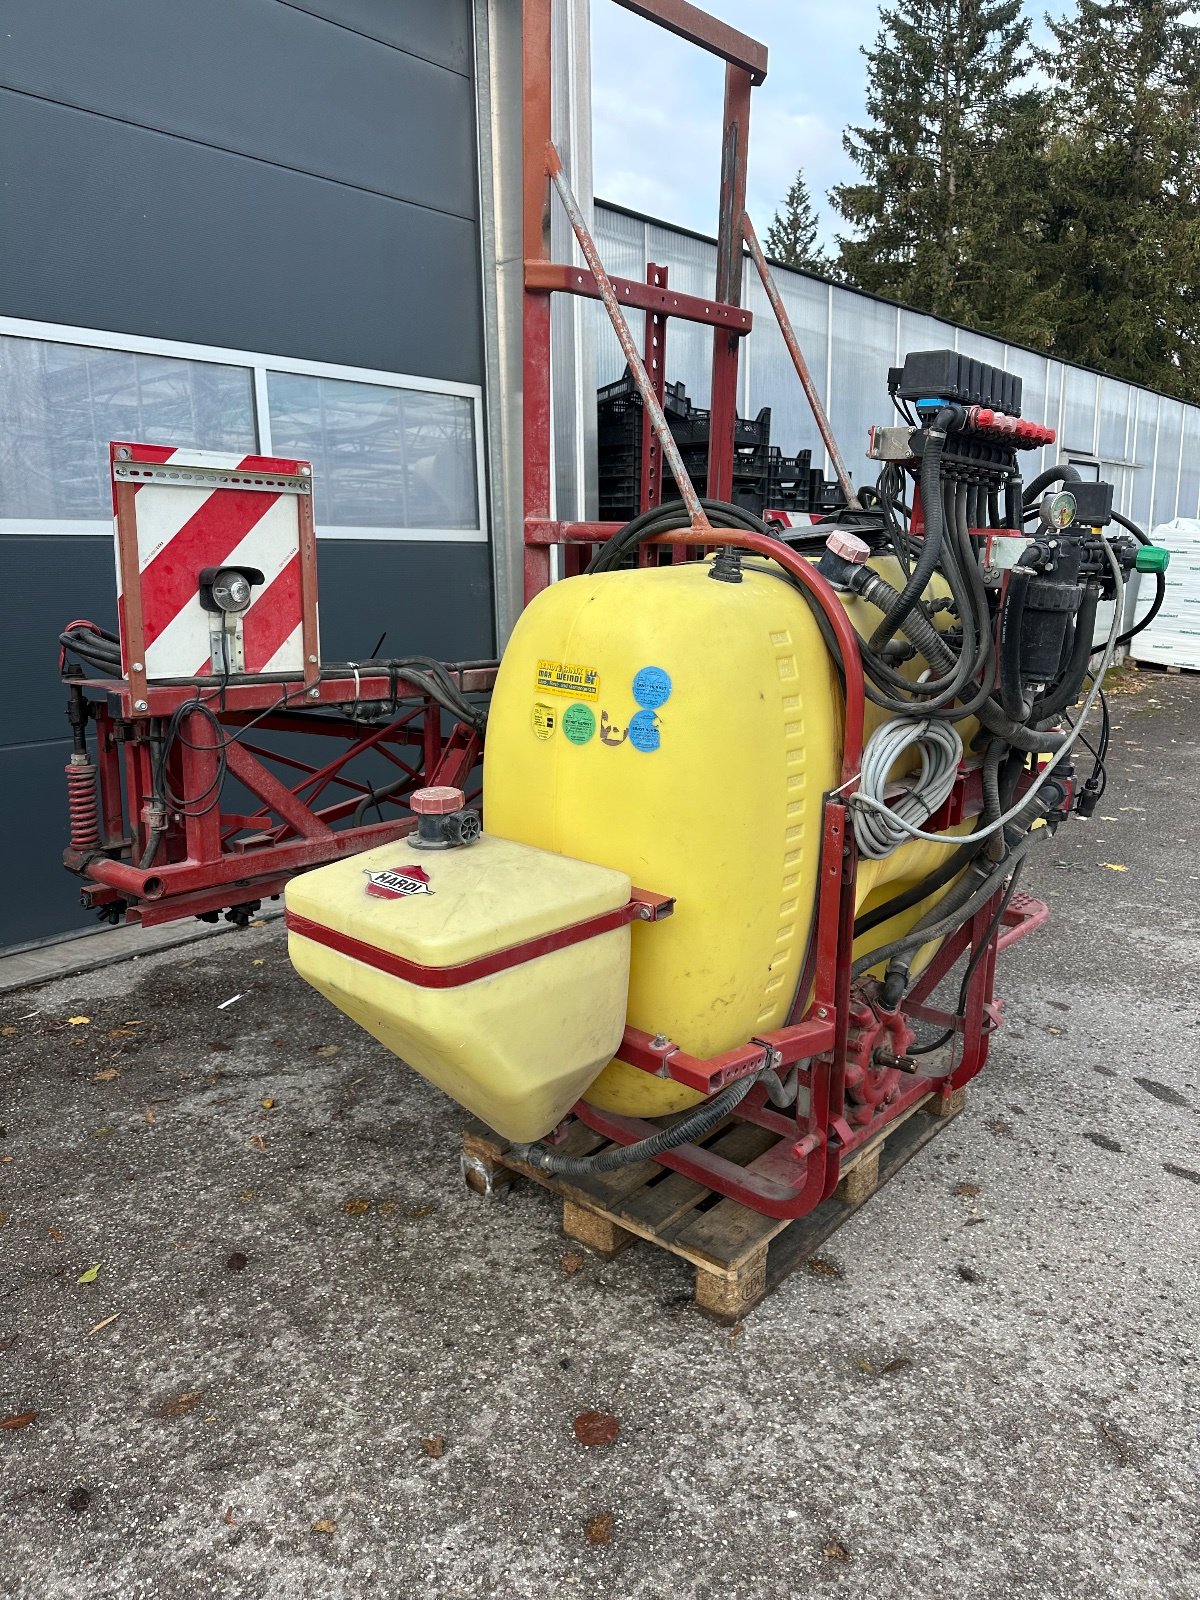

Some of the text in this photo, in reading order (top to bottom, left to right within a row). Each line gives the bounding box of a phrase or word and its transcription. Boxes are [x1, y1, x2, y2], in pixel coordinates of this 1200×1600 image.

[538, 670, 583, 684] MAX WEINDL
[374, 872, 423, 893] HARDI
